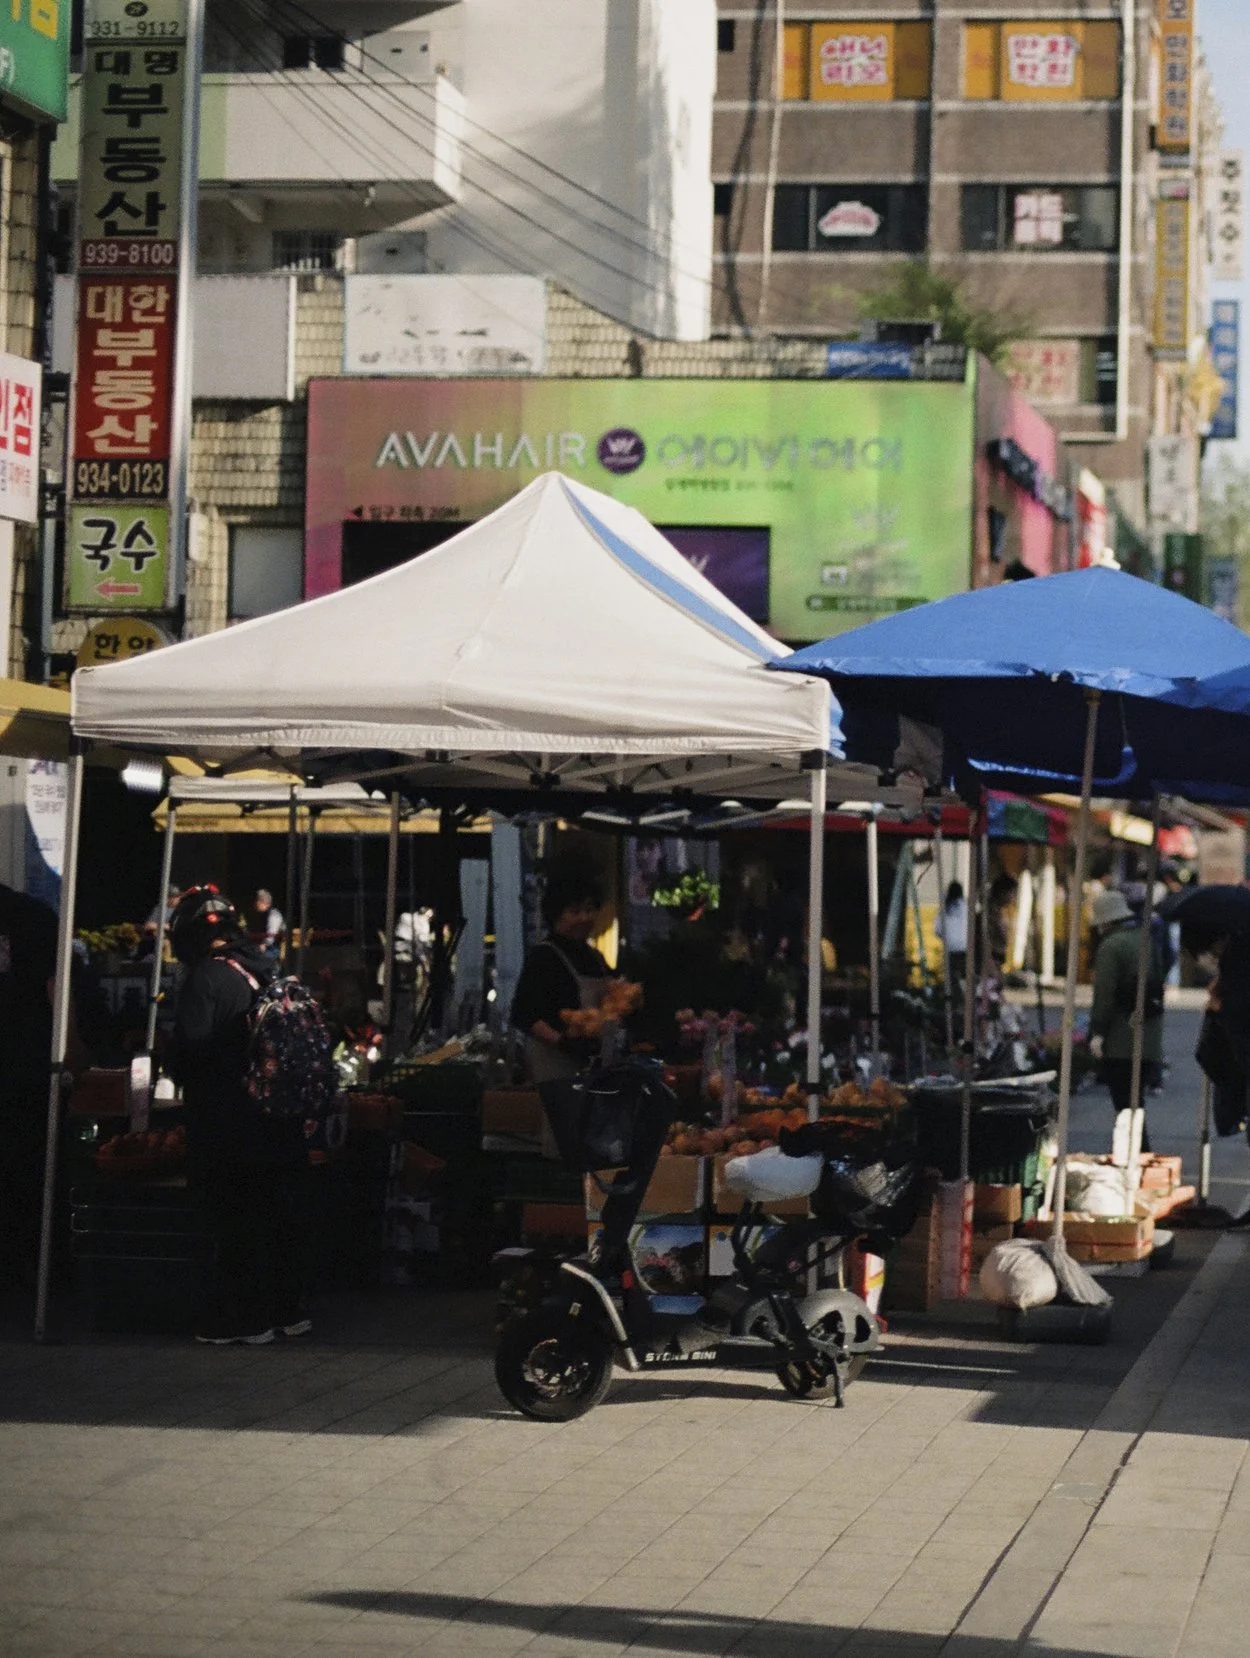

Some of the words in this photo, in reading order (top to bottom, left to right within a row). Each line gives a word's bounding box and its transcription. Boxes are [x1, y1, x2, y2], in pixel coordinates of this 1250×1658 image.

[94, 49, 179, 77] 대명
[96, 84, 169, 238] 부동산
[85, 243, 174, 266] 939-8100
[86, 283, 171, 325] 대한
[86, 329, 157, 456] 부동산
[77, 461, 164, 497] 934-0123
[80, 518, 159, 573] 국수
